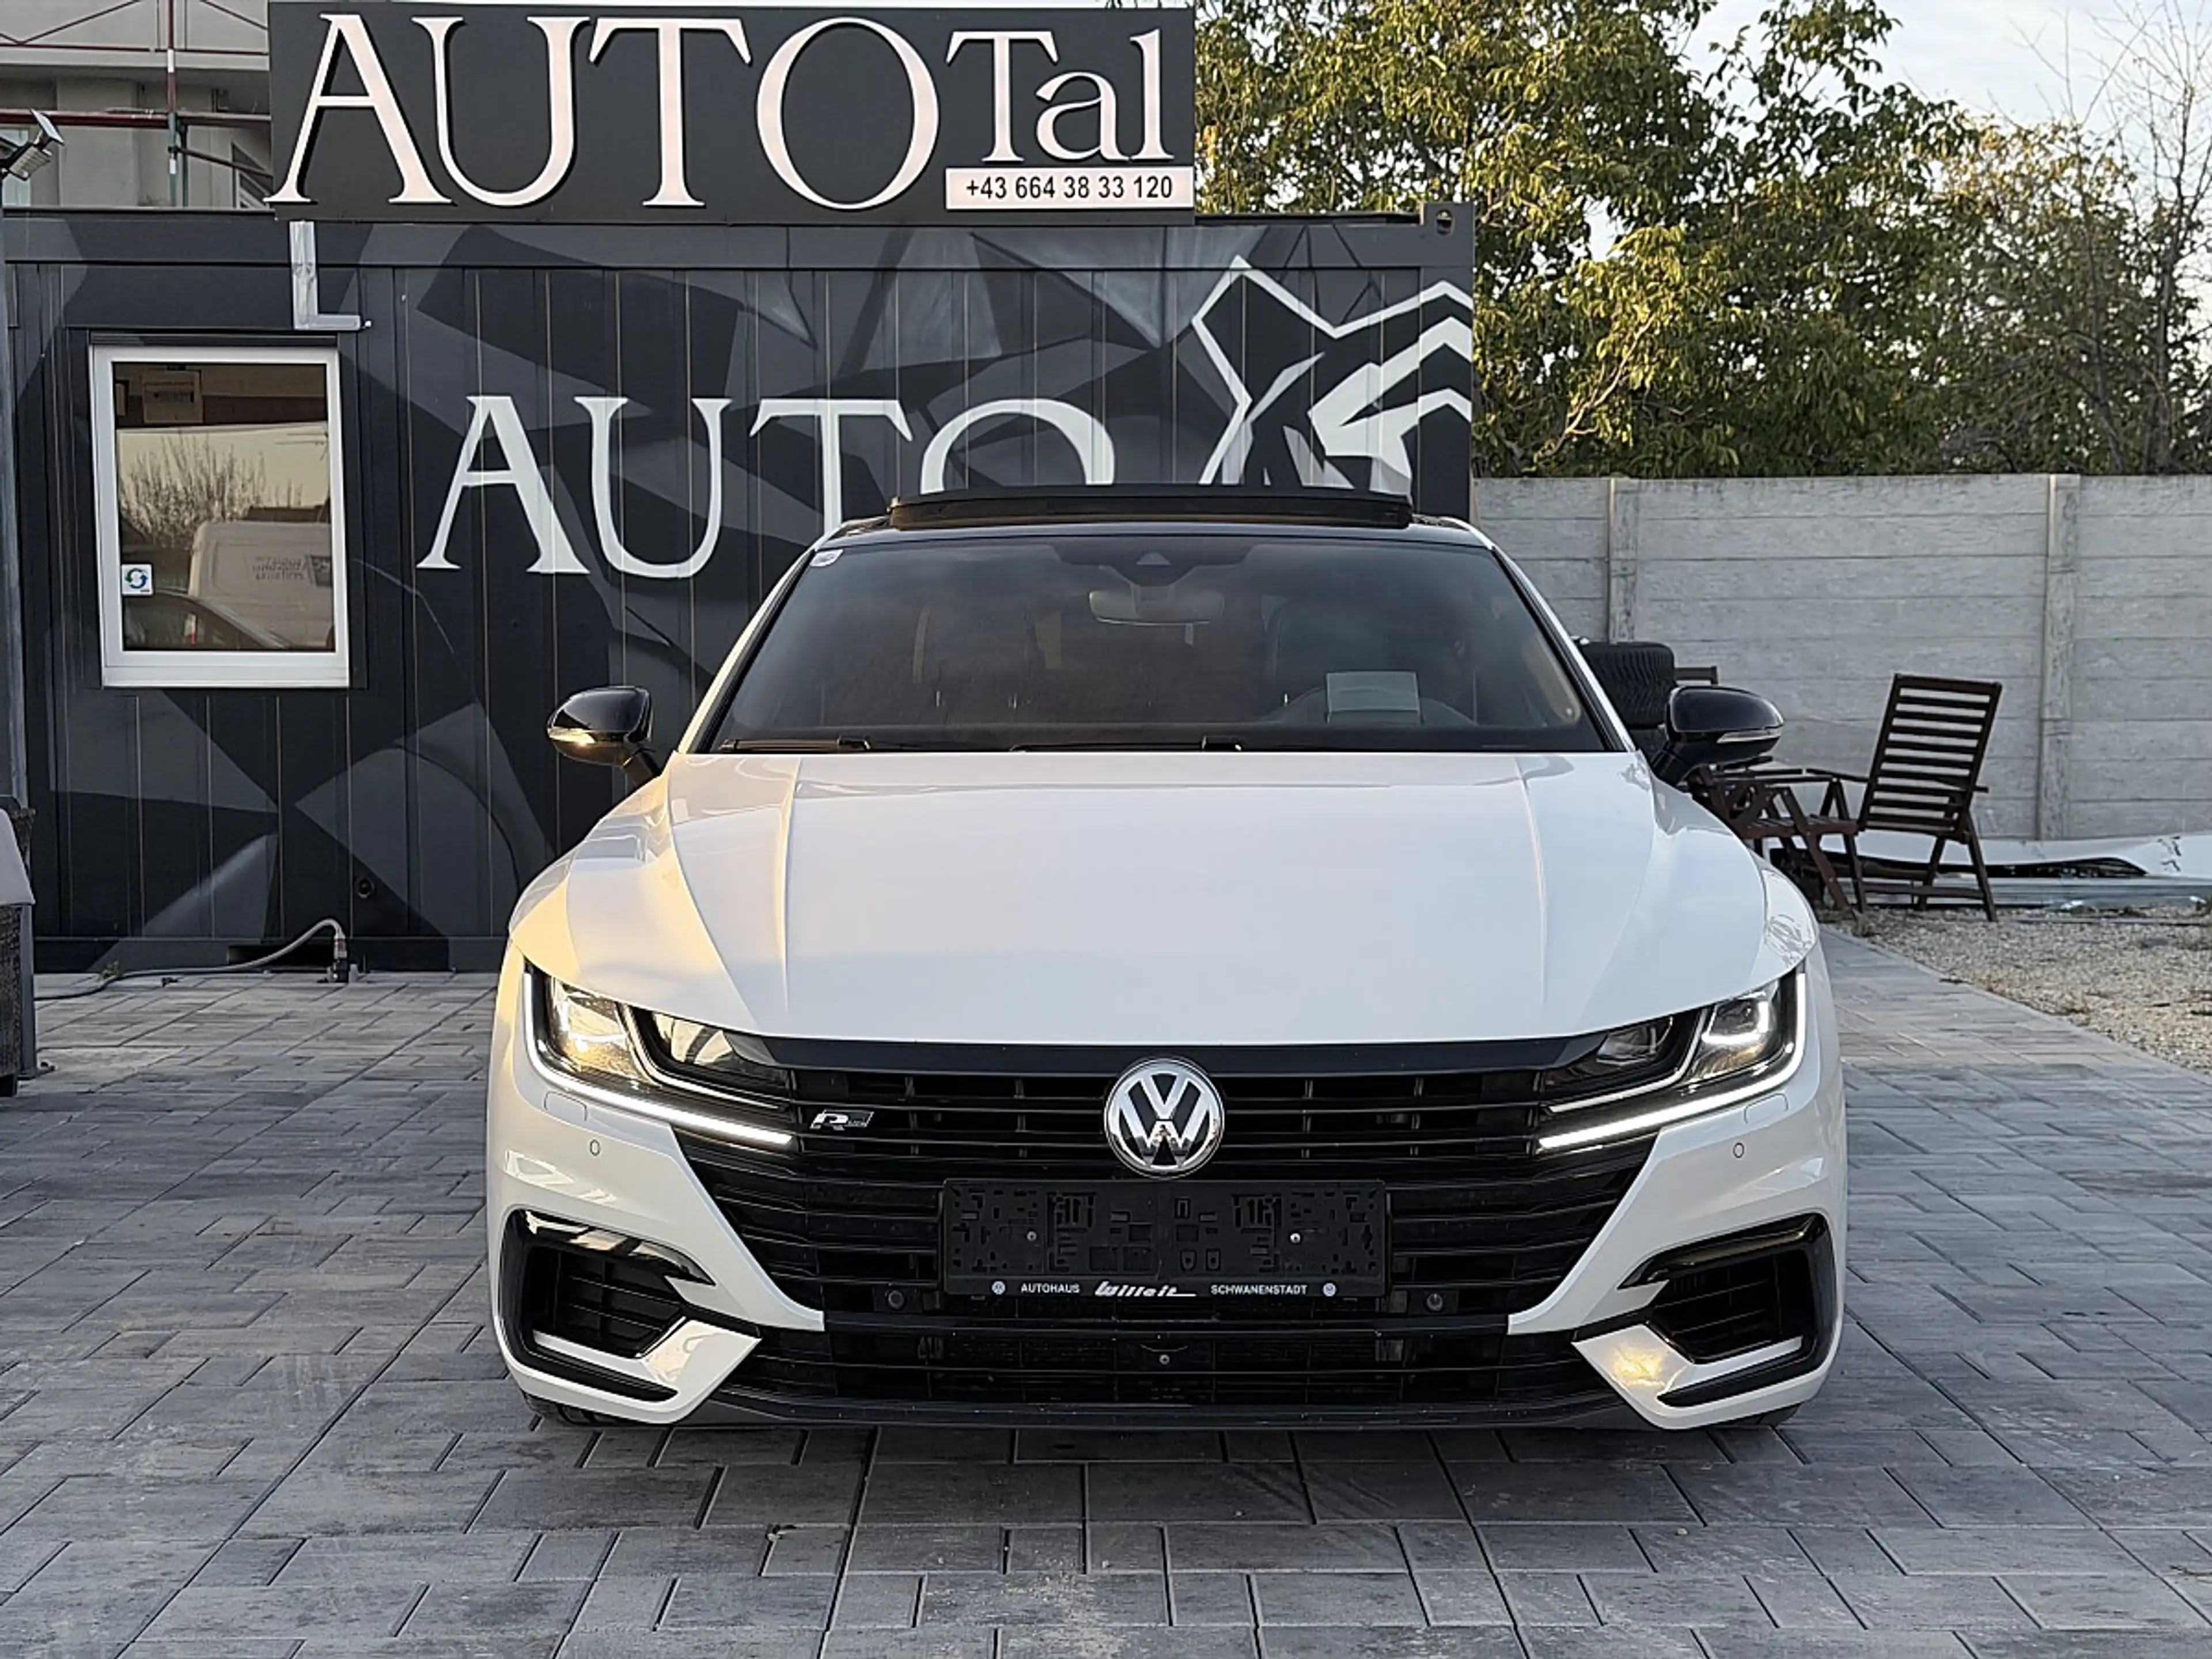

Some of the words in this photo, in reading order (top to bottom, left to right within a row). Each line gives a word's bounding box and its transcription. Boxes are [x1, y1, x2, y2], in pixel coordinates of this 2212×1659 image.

[263, 14, 939, 210] AUTO
[946, 29, 1174, 162] Tal
[966, 176, 1007, 199] +43
[1016, 175, 1055, 199] 664
[1064, 175, 1089, 198] 38
[1099, 175, 1124, 198] 33
[1133, 175, 1172, 198] 120
[1104, 1058, 1225, 1179] VW
[1021, 1283, 1080, 1293] AUTOHAUS
[1211, 1285, 1308, 1295] SCHWANENSTADT
